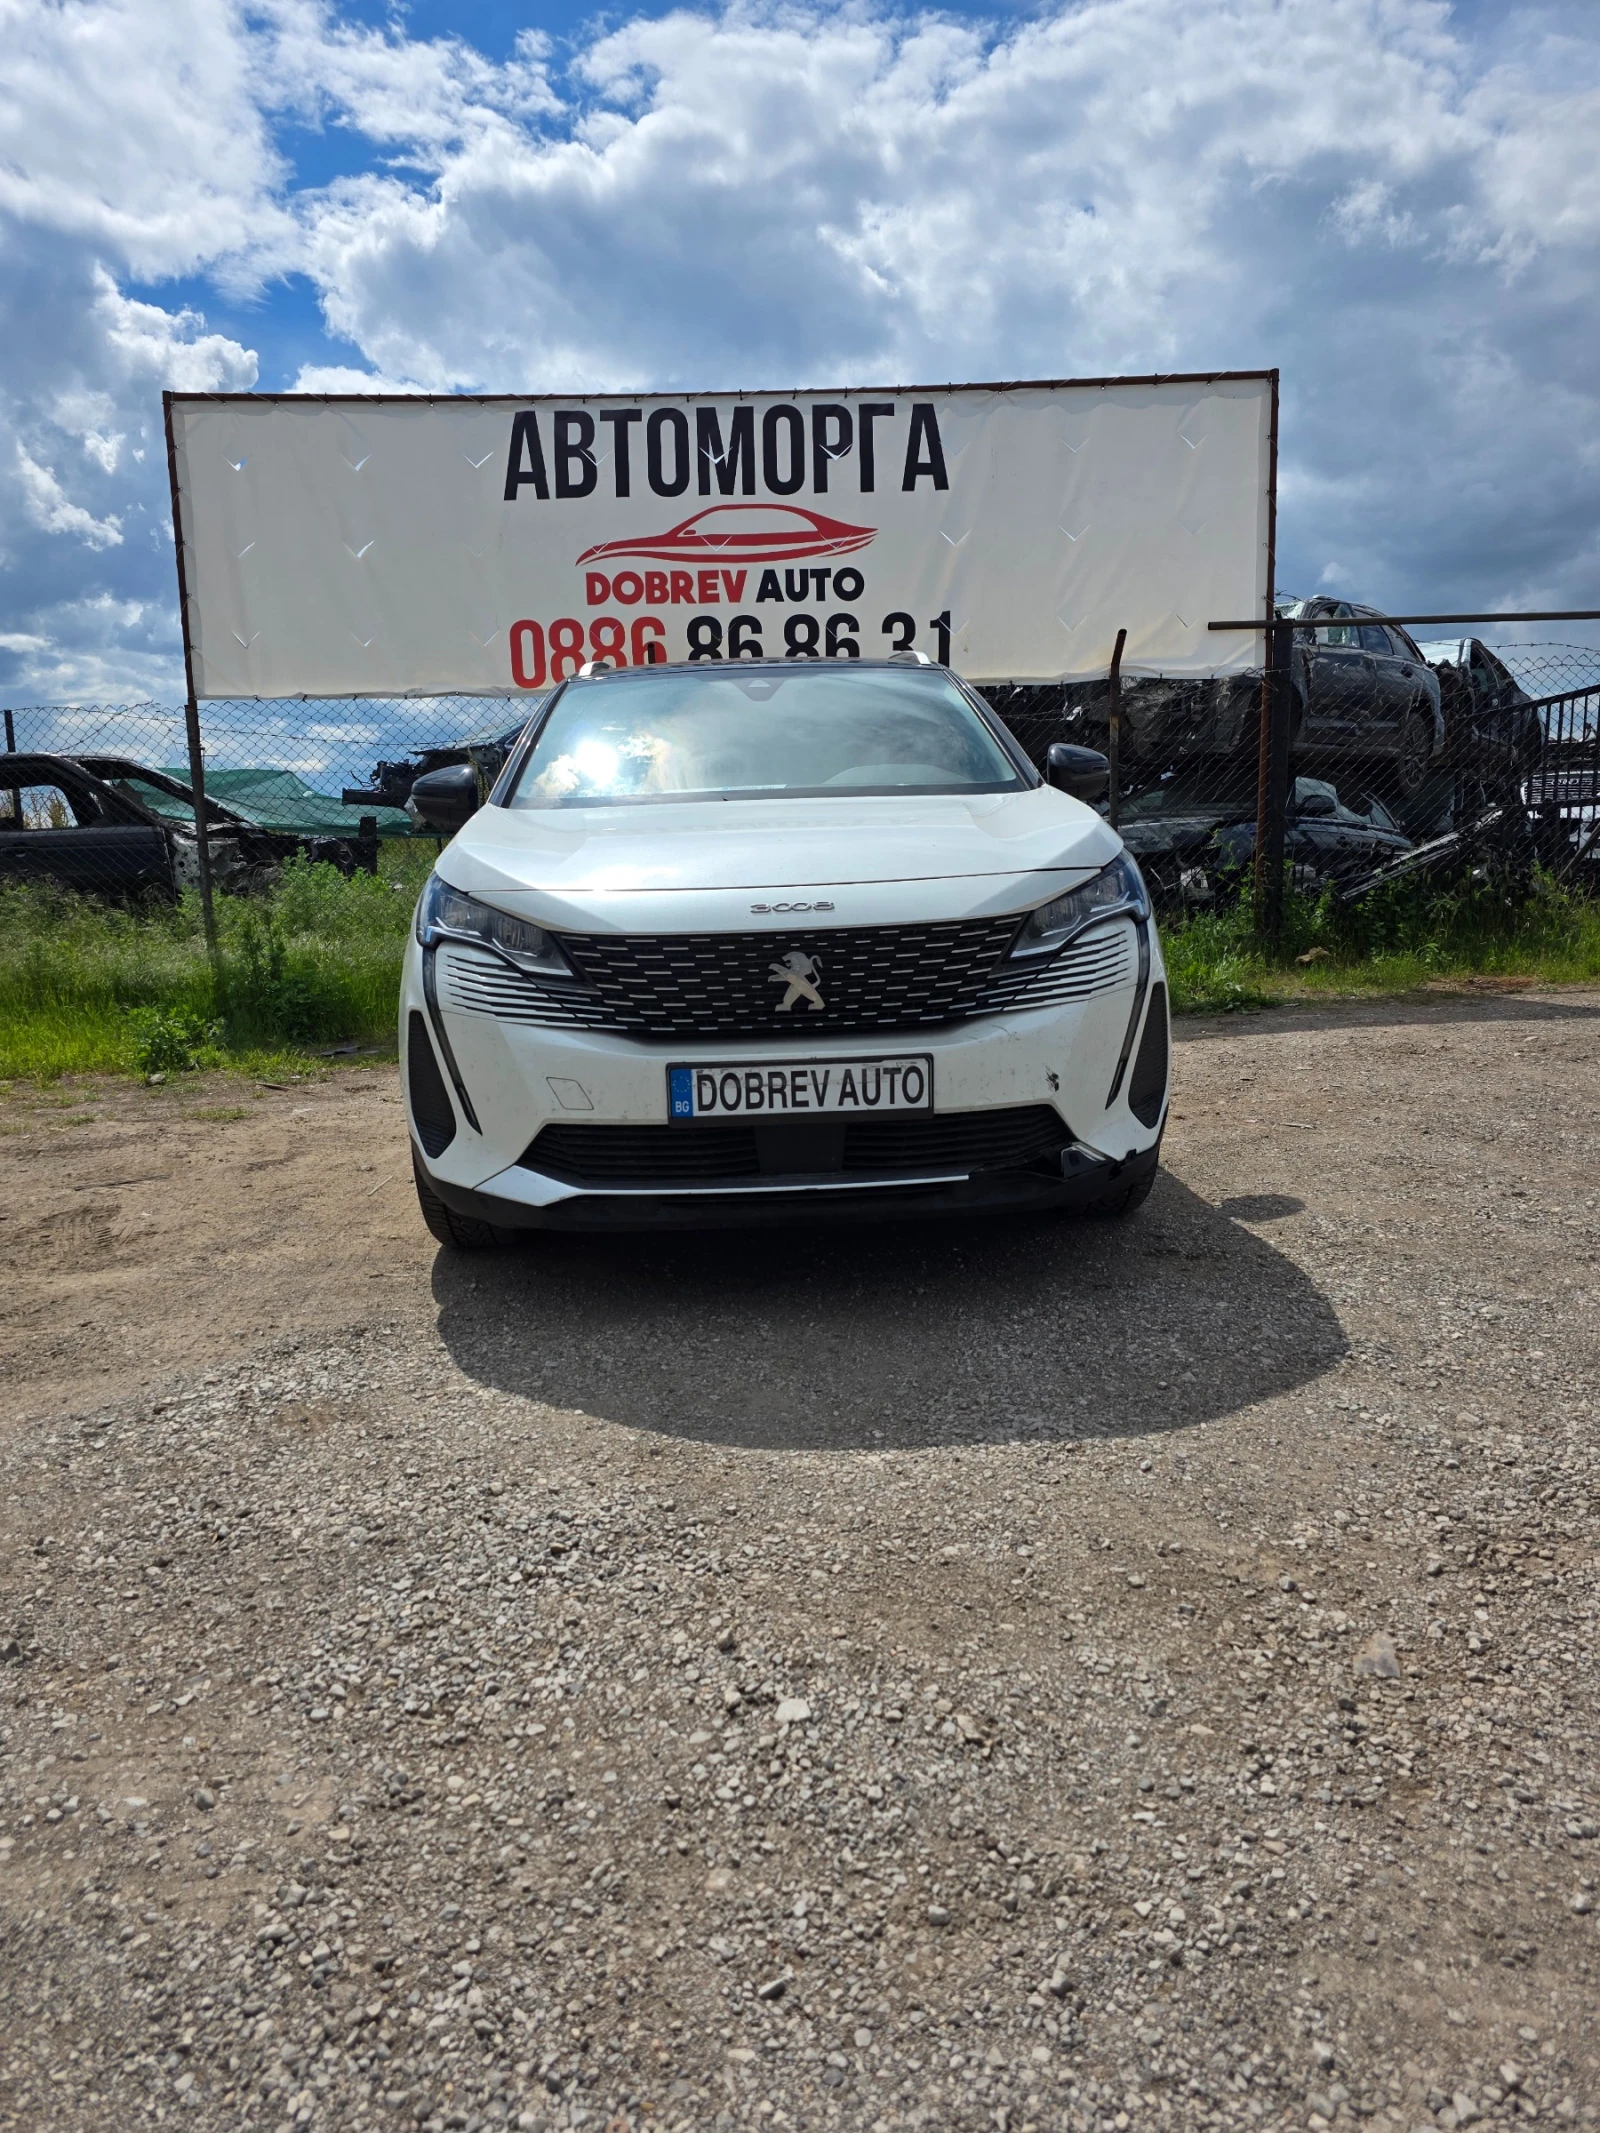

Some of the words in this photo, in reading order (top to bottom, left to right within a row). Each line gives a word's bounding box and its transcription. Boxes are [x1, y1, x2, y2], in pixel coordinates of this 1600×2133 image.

[504, 403, 949, 500] АВТОМОРГА
[586, 570, 748, 605] DOBREV
[756, 567, 865, 604] AUTO
[509, 616, 667, 688] 0886
[687, 613, 763, 661] 86
[783, 612, 860, 659] 86
[750, 901, 835, 914] 3008
[675, 1100, 690, 1113] BG
[697, 1069, 830, 1112] DOBREV
[838, 1066, 925, 1107] AUTO
